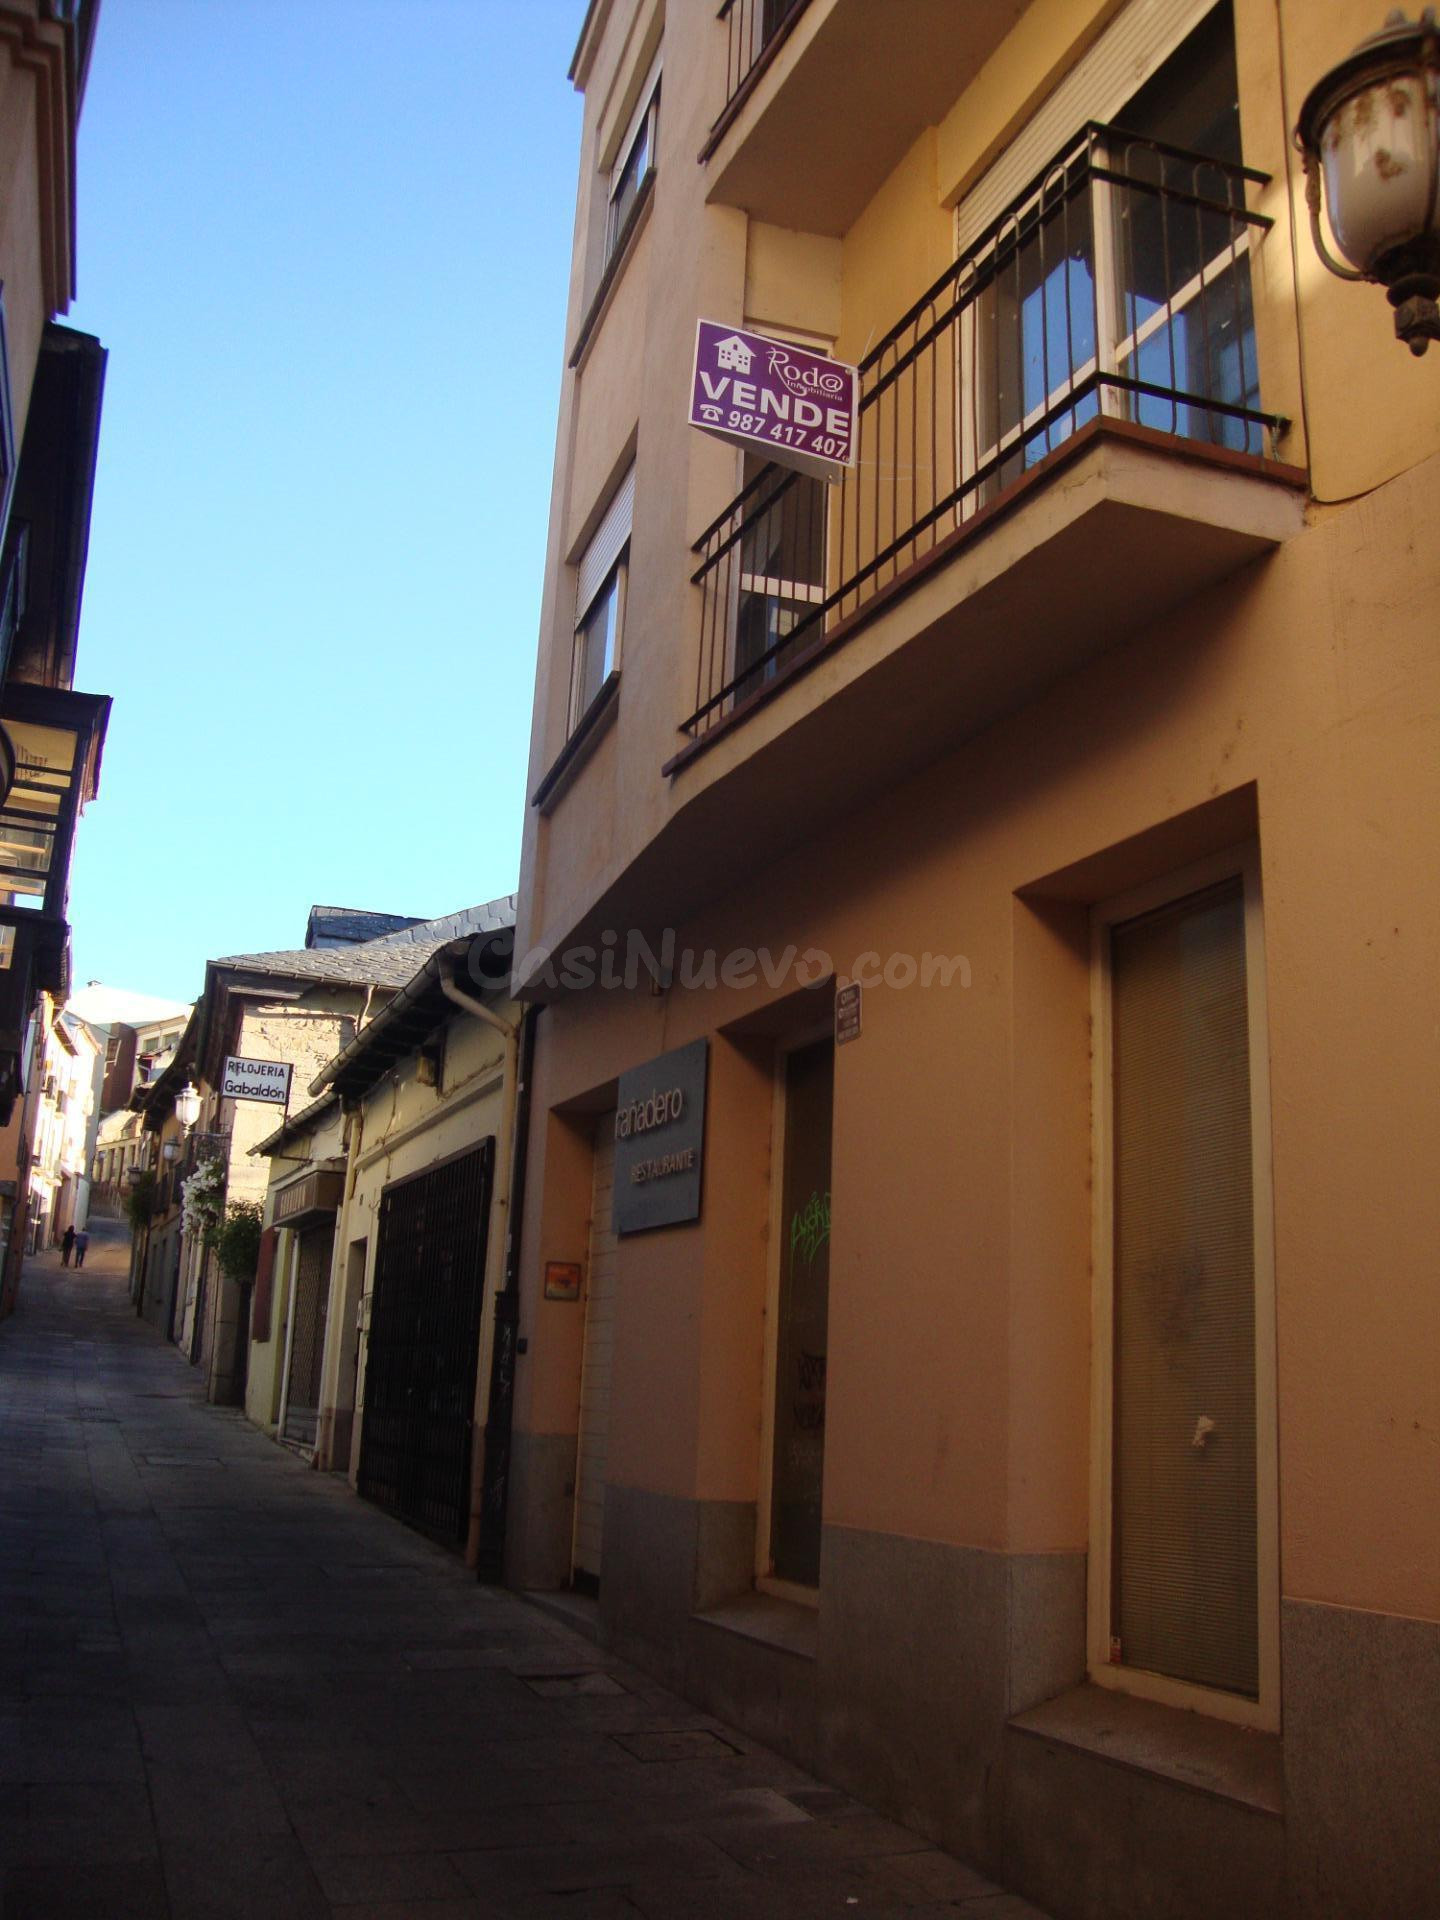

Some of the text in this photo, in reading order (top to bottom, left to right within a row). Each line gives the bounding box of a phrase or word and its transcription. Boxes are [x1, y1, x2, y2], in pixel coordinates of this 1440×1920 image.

[700, 371, 849, 437] VENDE
[727, 410, 848, 458] 987 417 407
[225, 1080, 284, 1099] Gabaldón
[631, 1147, 694, 1183] RESTAURANTE
